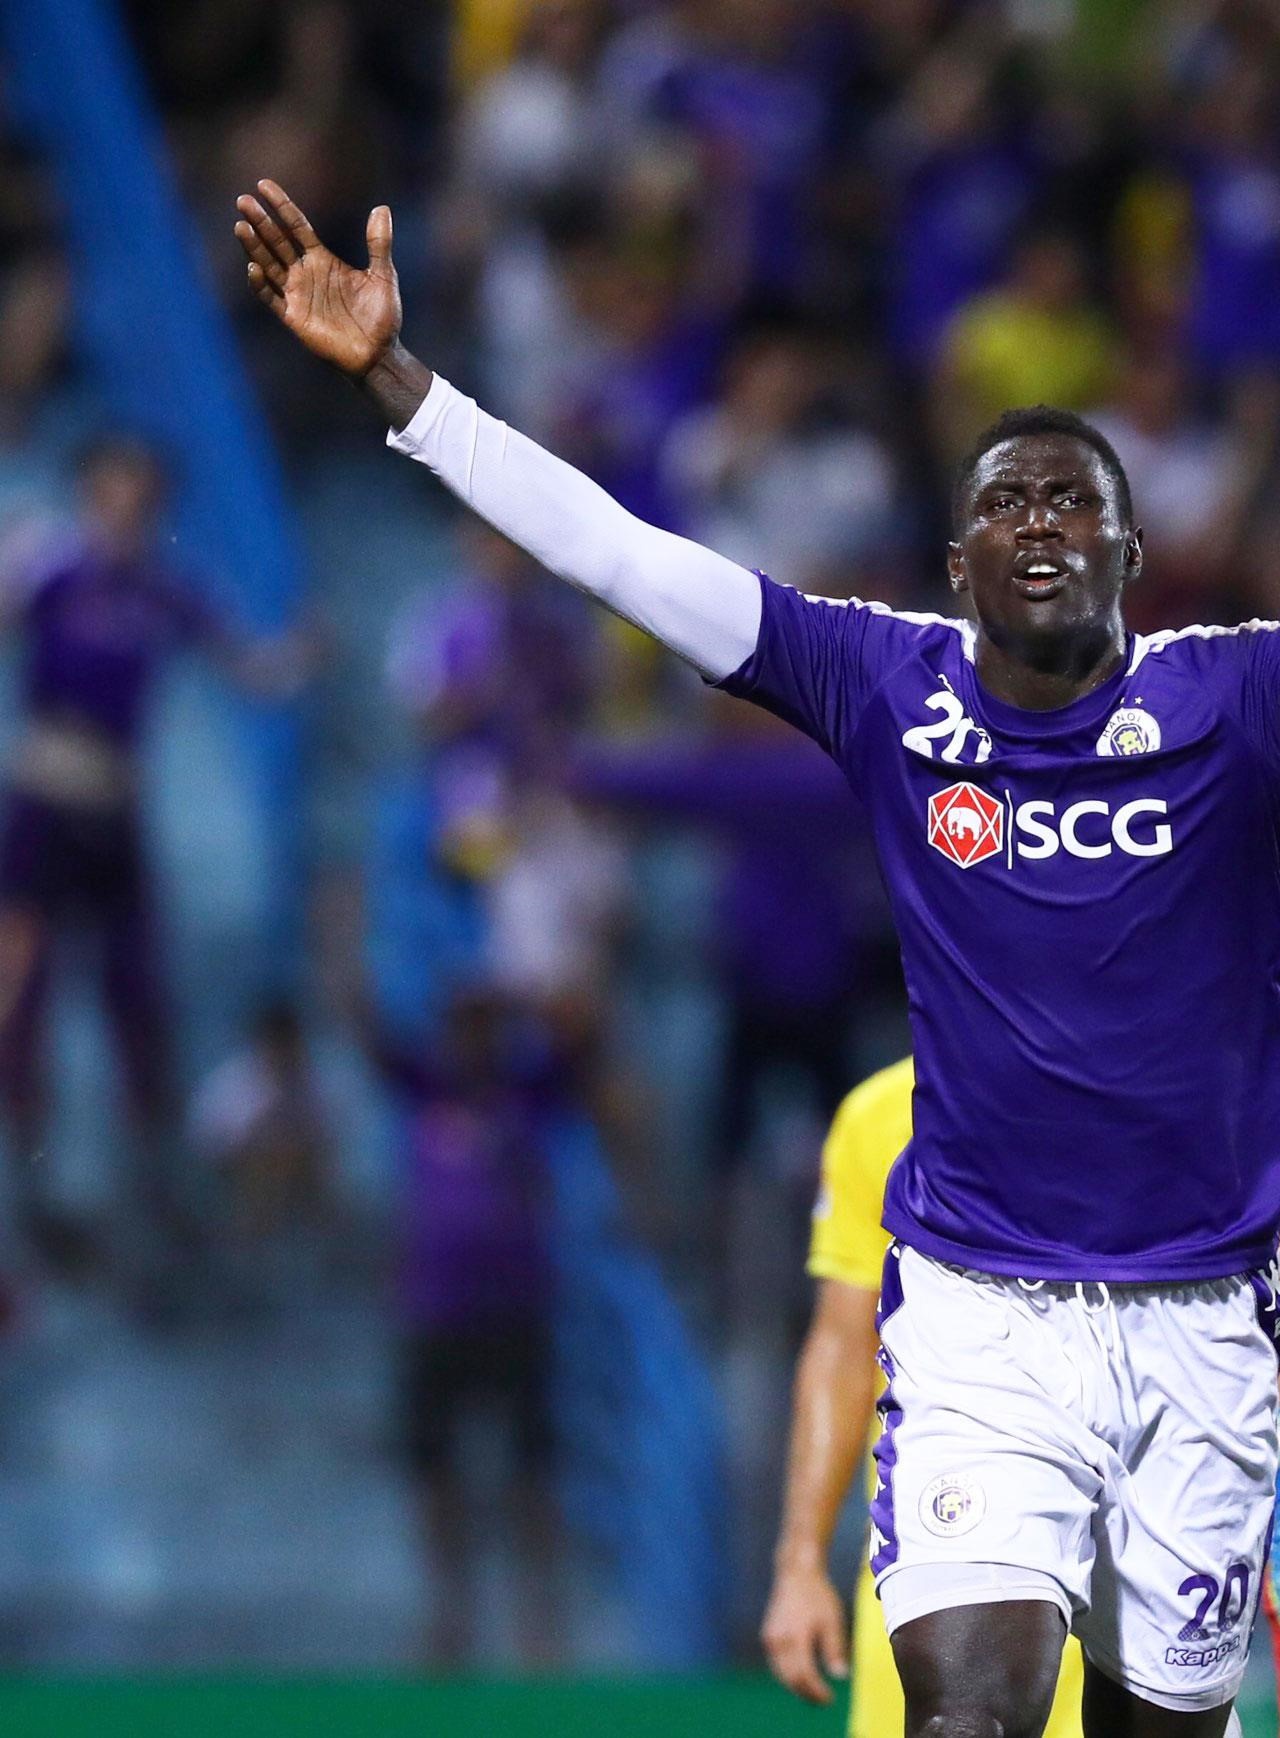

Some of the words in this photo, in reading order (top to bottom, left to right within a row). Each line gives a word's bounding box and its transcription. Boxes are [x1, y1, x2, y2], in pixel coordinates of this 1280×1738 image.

[1015, 799, 1173, 859] SCG
[1177, 1563, 1249, 1642] 20
[1165, 1635, 1241, 1667] Kappa
